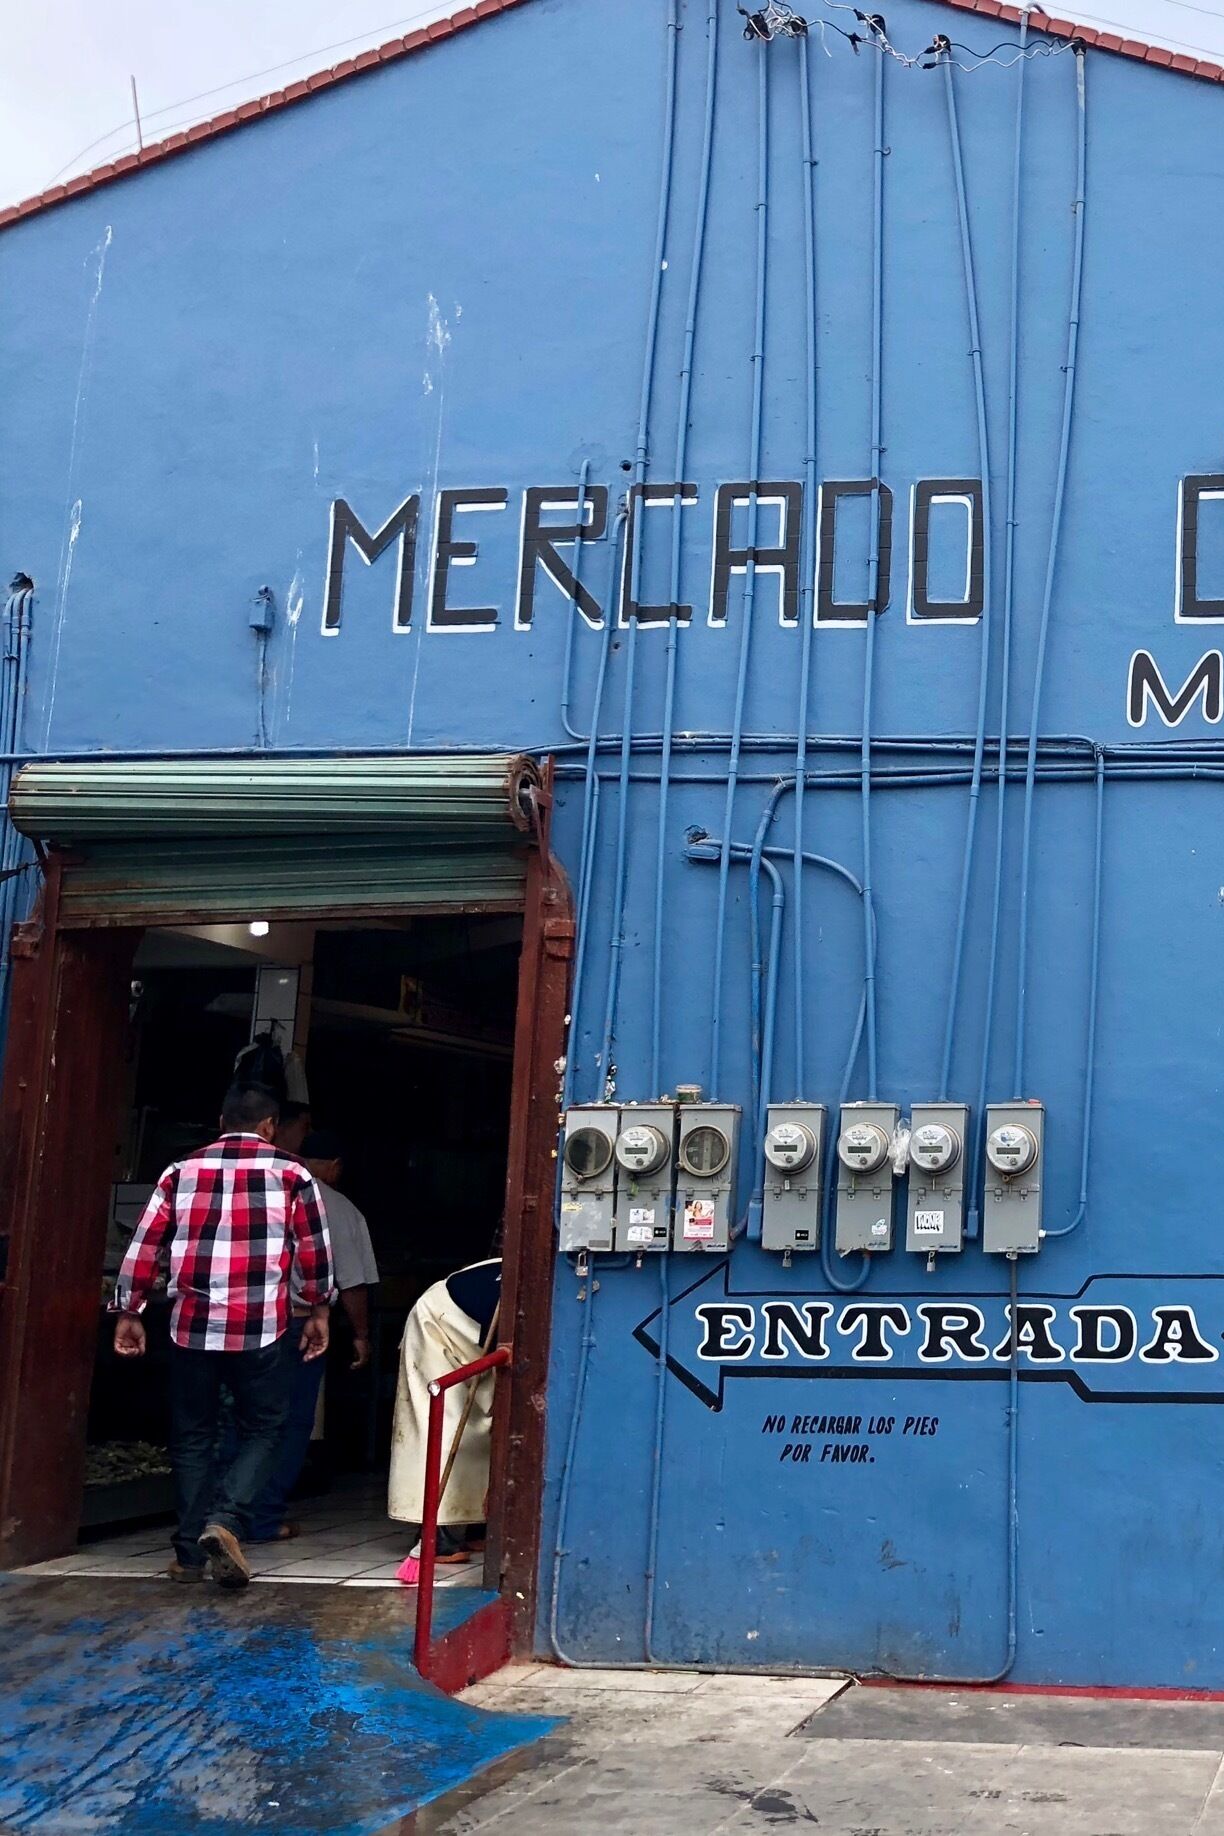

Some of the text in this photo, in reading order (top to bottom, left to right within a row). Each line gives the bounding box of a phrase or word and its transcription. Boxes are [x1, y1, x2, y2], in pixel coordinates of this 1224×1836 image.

[320, 479, 984, 637] MERCADO
[695, 1301, 1220, 1364] ENTRADA
[761, 1415, 939, 1436] NO RECARGAR LOS PIES
[780, 1443, 876, 1463] POR FAVOR.
